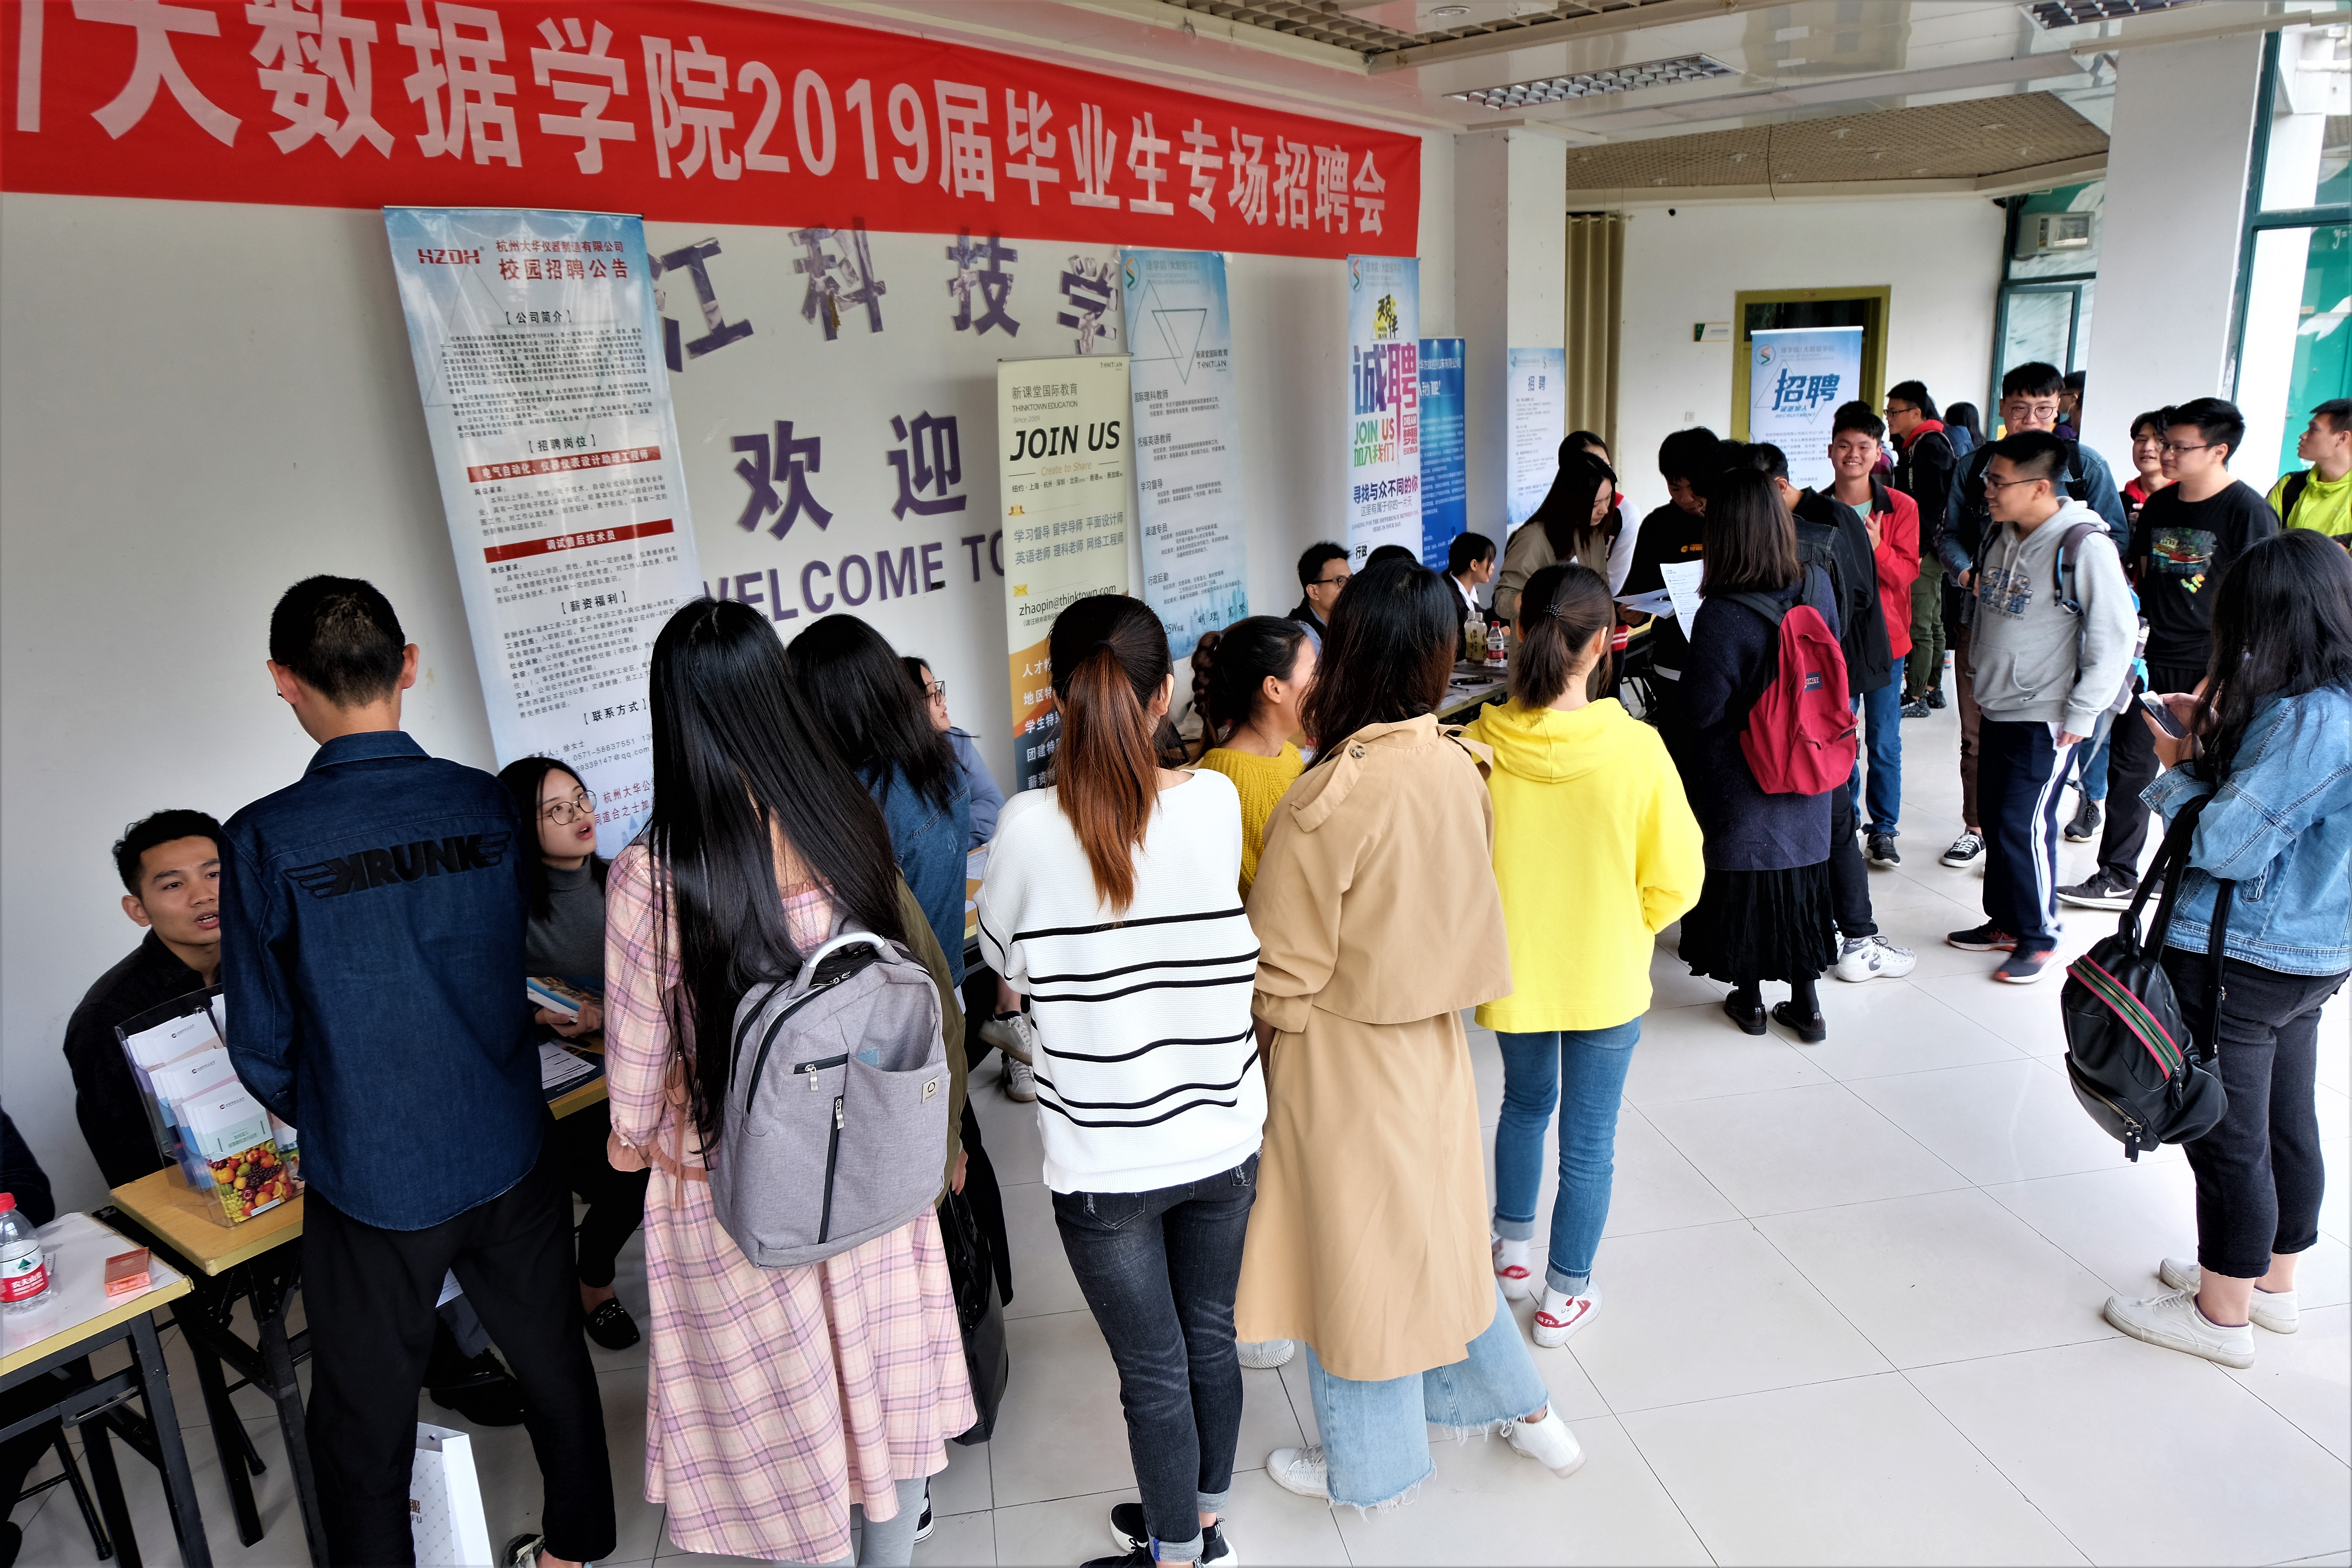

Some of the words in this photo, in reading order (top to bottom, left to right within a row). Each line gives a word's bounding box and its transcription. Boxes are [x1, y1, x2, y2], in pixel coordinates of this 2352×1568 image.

[496, 240, 624, 253] 杭州大华仪器制造有限公司
[499, 258, 628, 280] 校园招聘公告
[1012, 383, 1078, 400] 新课堂国际教育
[1528, 375, 1546, 391] 招聘
[1772, 368, 1840, 411] 招聘
[1134, 390, 1168, 402] 国际理科教师
[1012, 403, 1047, 412] THINKTOWN
[1048, 401, 1078, 410] EDUCATION
[1009, 425, 1079, 461] JOIN
[1088, 420, 1120, 452] US
[1138, 433, 1171, 447] 托福英语教师
[1354, 419, 1378, 445] JOIN
[1382, 418, 1394, 441] US
[1354, 442, 1394, 467] 加入我们
[731, 411, 967, 540] 欢迎
[1041, 466, 1062, 476] Create
[1073, 462, 1092, 471] Share
[1141, 479, 1163, 491] 学习督导
[1354, 474, 1418, 504] 寻找与众不同的你
[1361, 496, 1412, 516] 这里有属于你的一片天
[1014, 525, 1050, 543] 学习督导
[1053, 519, 1083, 537] 留学导师
[1086, 512, 1123, 530] 平面设计师
[1145, 523, 1167, 537] 渠道专员
[546, 531, 615, 550] 调试售后技术员
[1015, 546, 1051, 565] 英语老师
[1053, 539, 1083, 557] 理科老师
[1087, 532, 1124, 550] 网络工程师
[1148, 572, 1169, 586] 行政后勤
[604, 780, 653, 804] 杭州大华公
